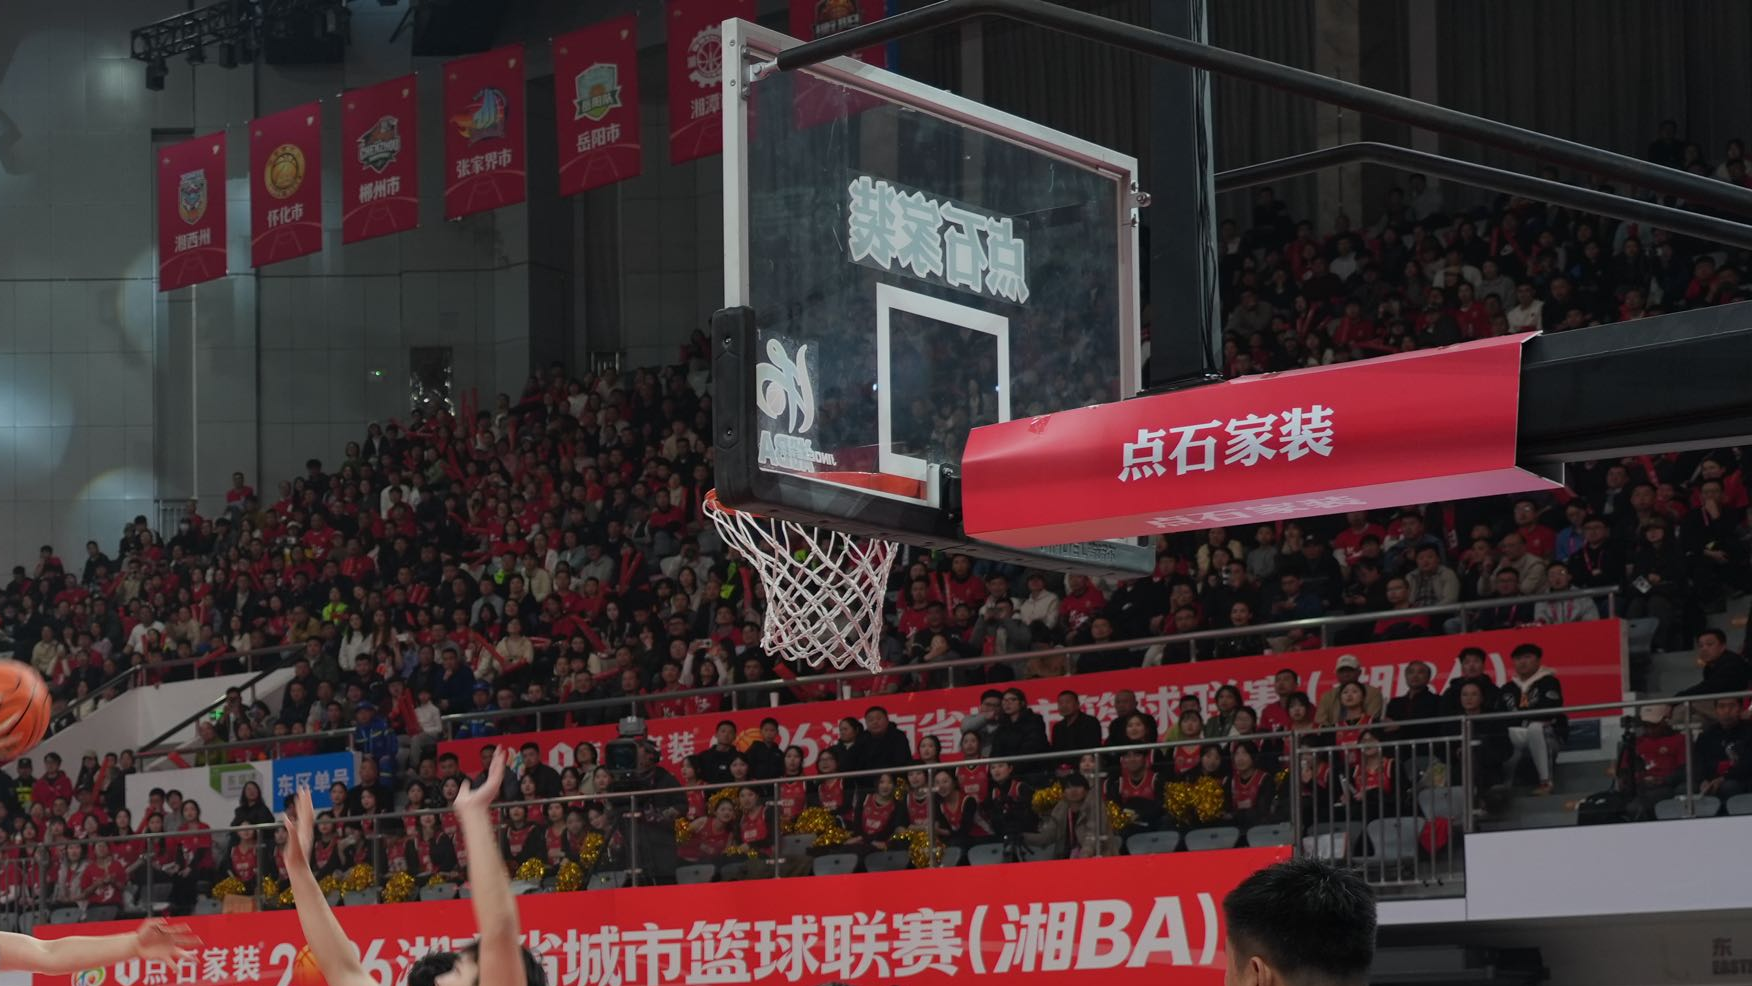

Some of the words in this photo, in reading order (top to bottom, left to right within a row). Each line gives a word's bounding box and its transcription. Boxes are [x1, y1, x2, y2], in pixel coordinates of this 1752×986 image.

[576, 123, 621, 152] 岳阳市
[456, 148, 512, 178] 张家界市
[267, 203, 304, 229] 怀化市
[174, 228, 211, 252] 湘西州
[1117, 404, 1335, 483] 点石家装
